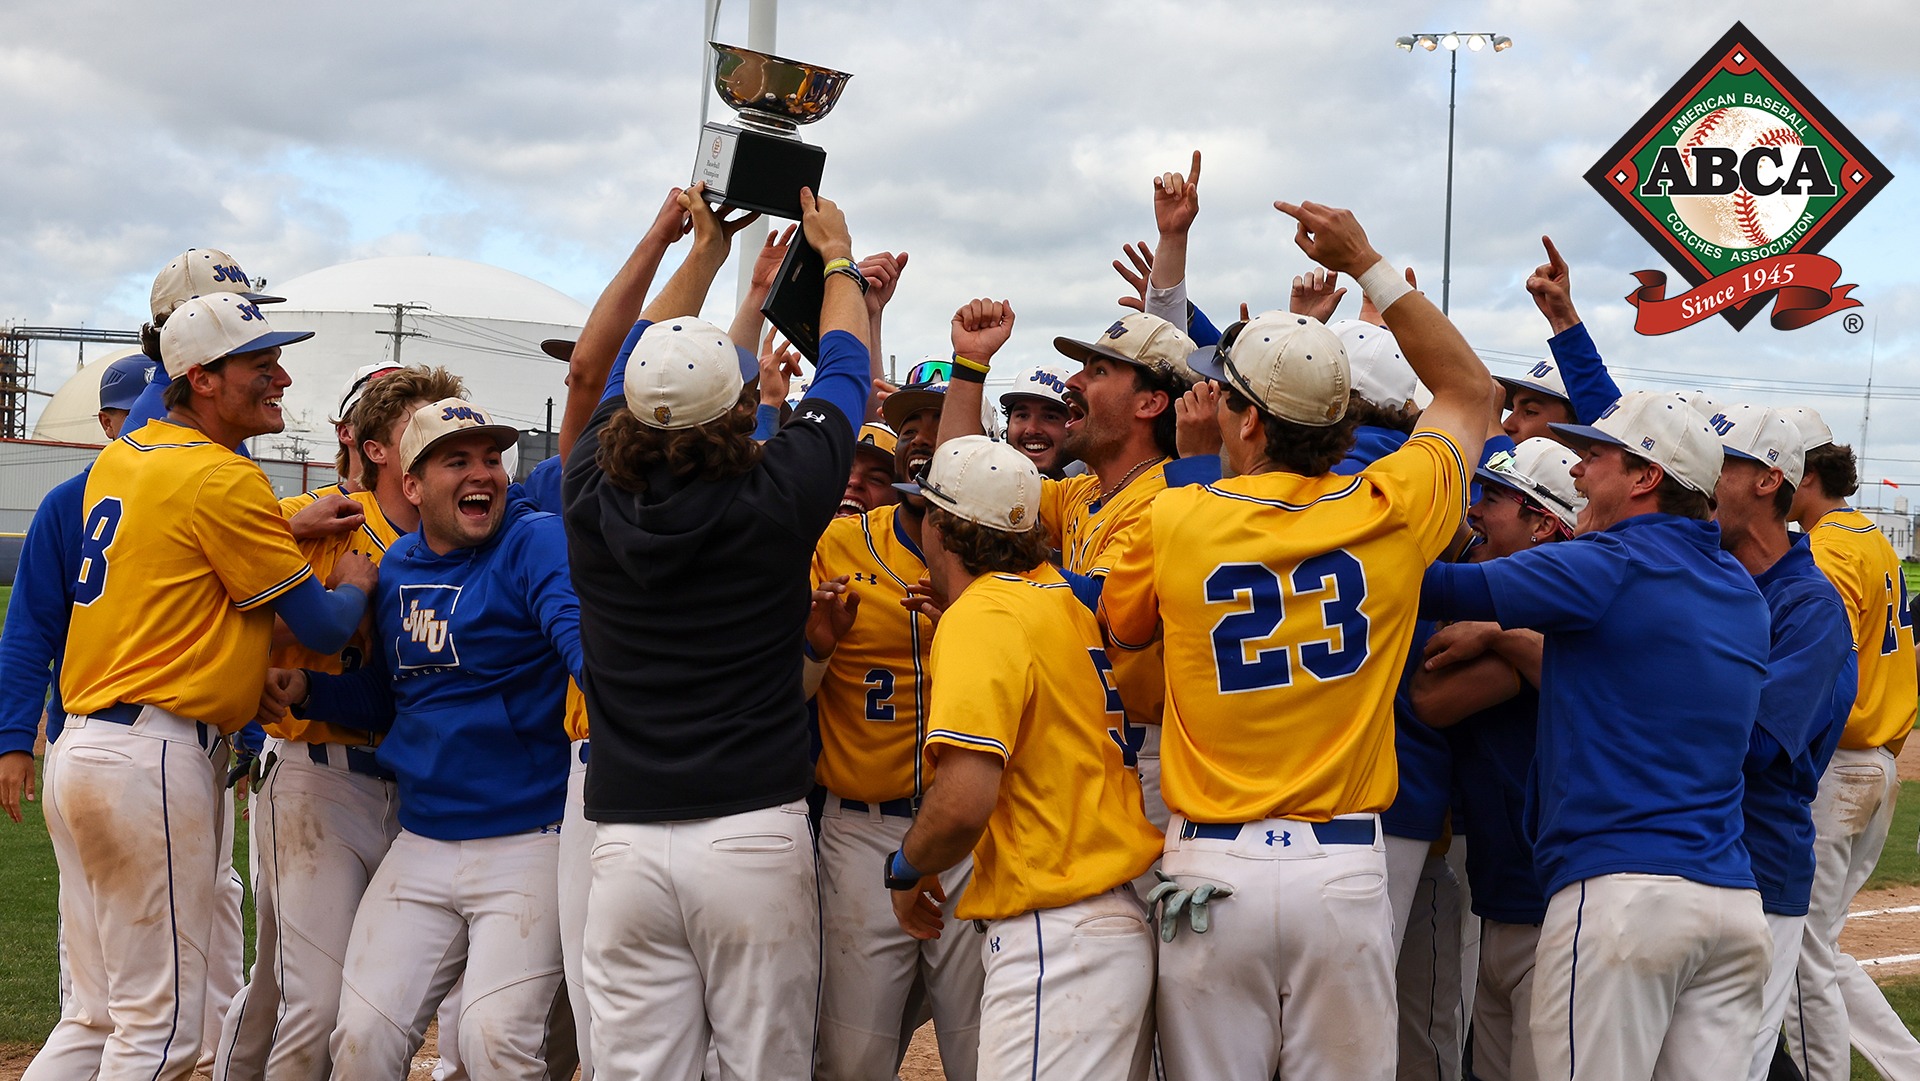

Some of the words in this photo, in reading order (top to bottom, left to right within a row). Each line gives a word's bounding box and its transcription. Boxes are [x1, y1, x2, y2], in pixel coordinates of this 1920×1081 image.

[1029, 370, 1066, 394] JWU
[441, 406, 486, 425] JWU
[1709, 412, 1736, 437] WU
[74, 496, 124, 607] 8
[403, 599, 448, 653] JWU
[1203, 548, 1371, 695] 23
[863, 668, 896, 722] 2
